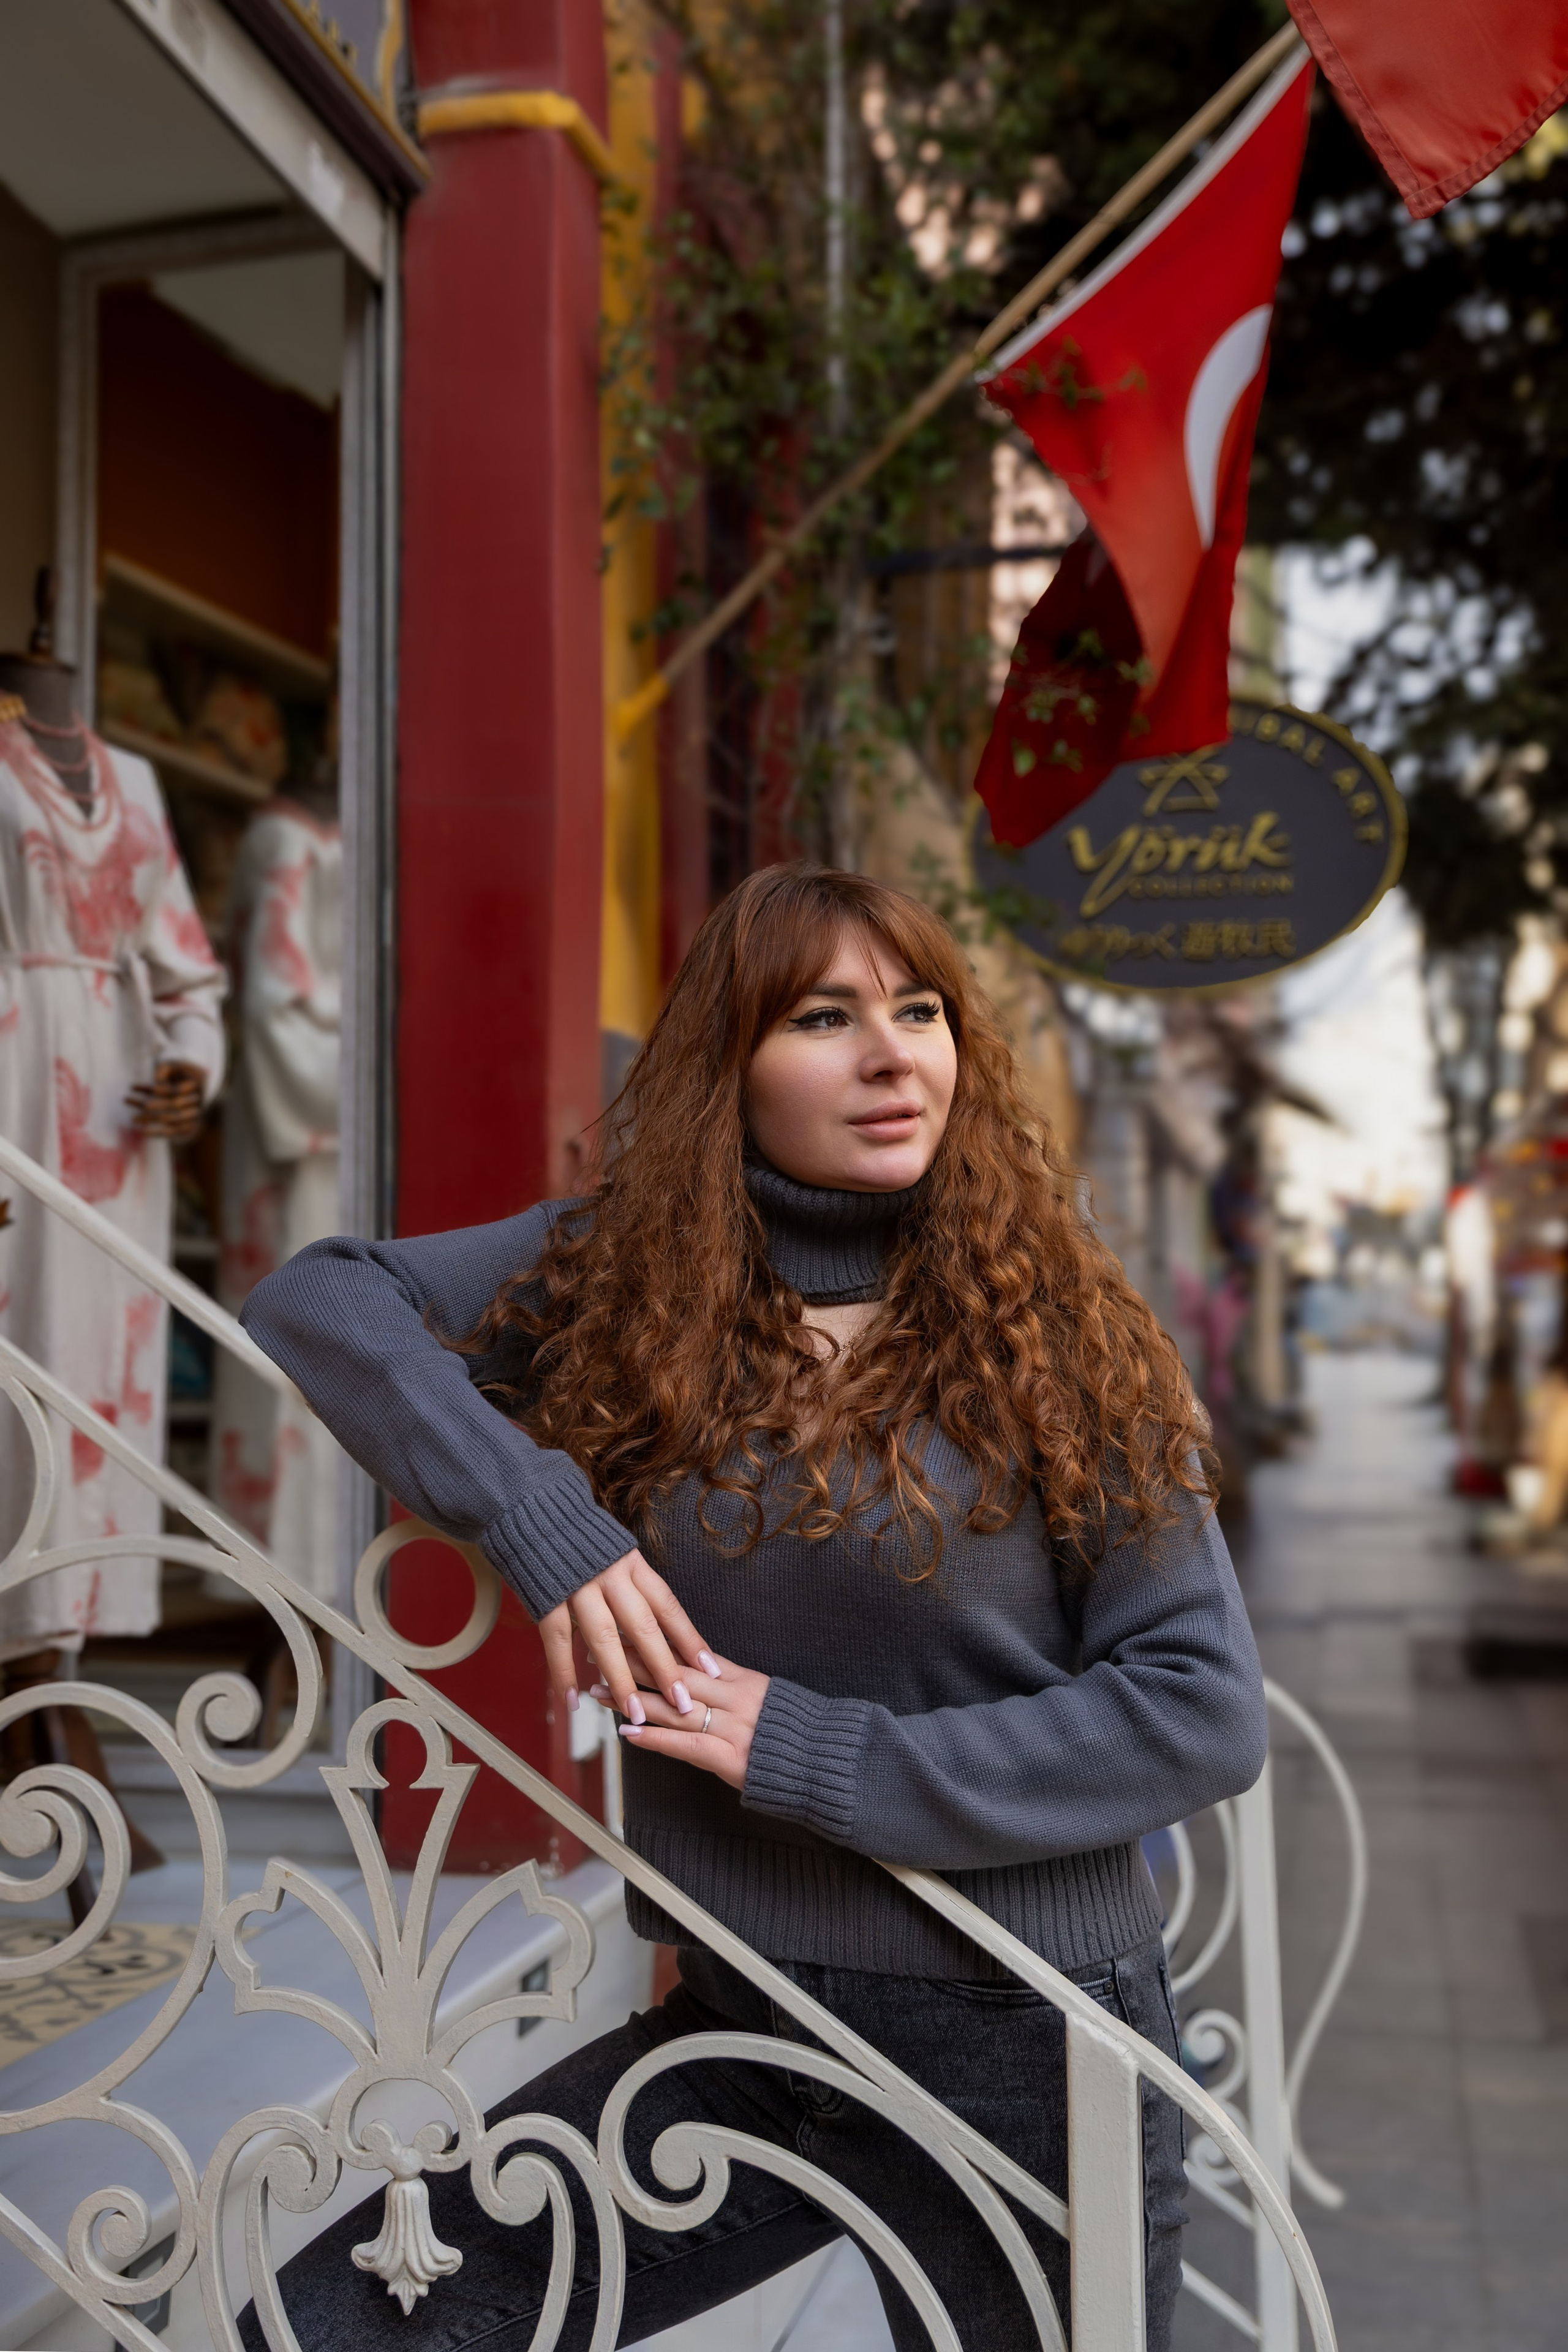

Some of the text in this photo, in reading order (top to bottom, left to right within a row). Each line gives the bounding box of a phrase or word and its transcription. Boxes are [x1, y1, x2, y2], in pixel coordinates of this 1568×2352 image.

[1332, 767, 1384, 845] ART
[1066, 812, 1293, 919] Yörük
[1129, 874, 1294, 898] COLLECTION
